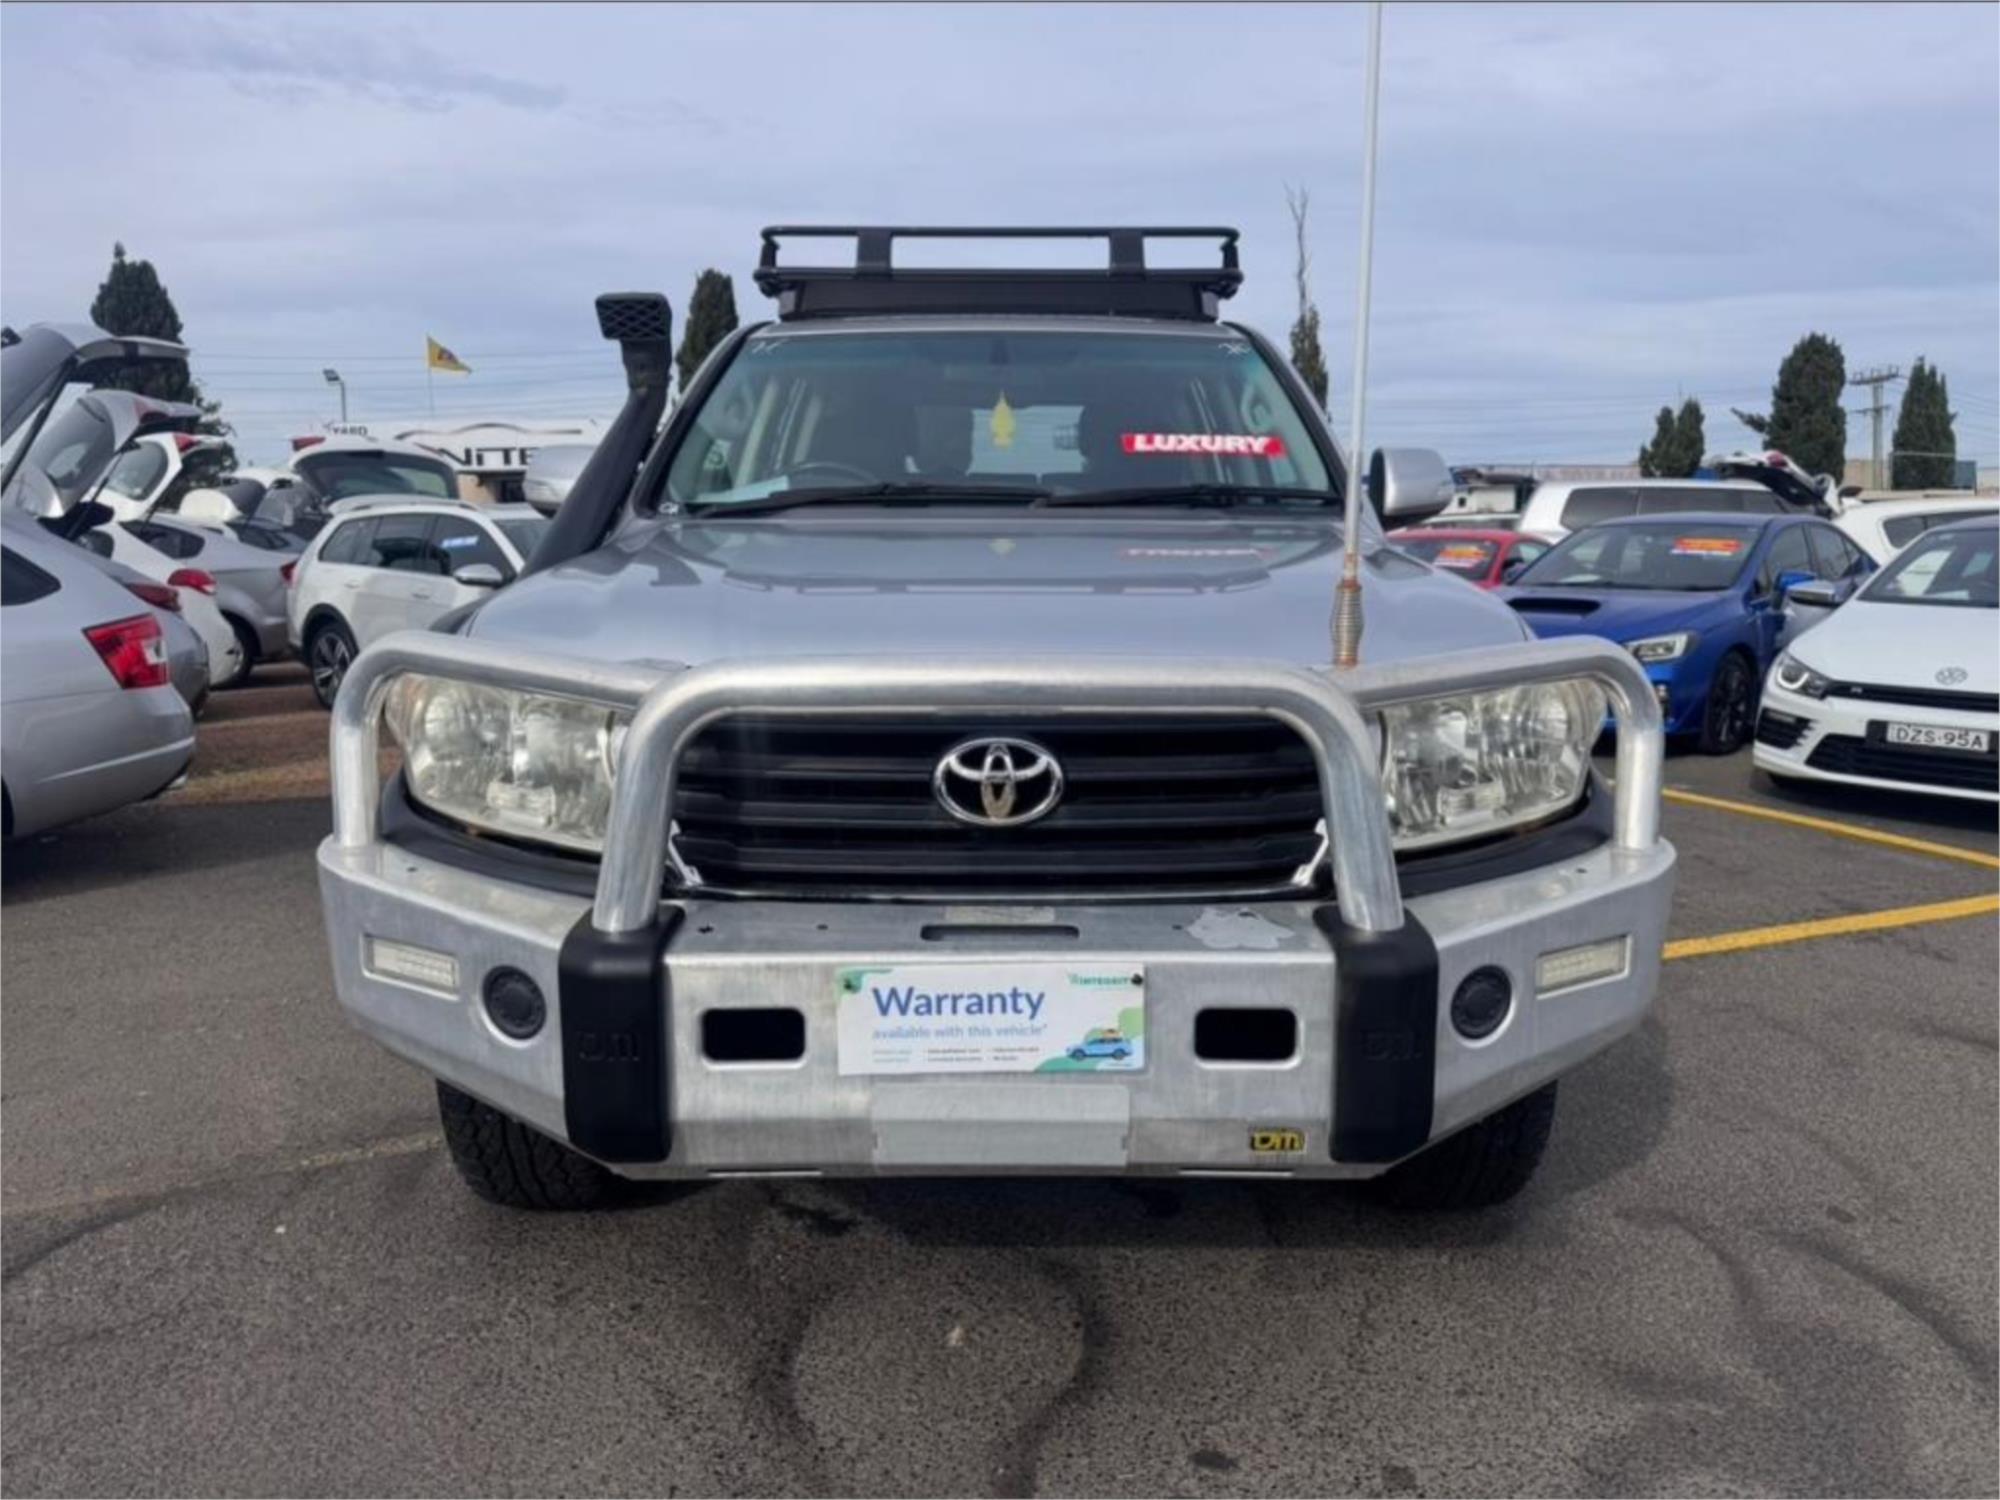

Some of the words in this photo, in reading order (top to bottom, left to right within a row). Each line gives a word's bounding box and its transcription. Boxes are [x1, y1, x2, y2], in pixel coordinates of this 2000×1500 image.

[1134, 433, 1271, 454] LUXURY
[872, 986, 1045, 1020] Warranty
[935, 1025, 963, 1038] with
[968, 1024, 992, 1037] this
